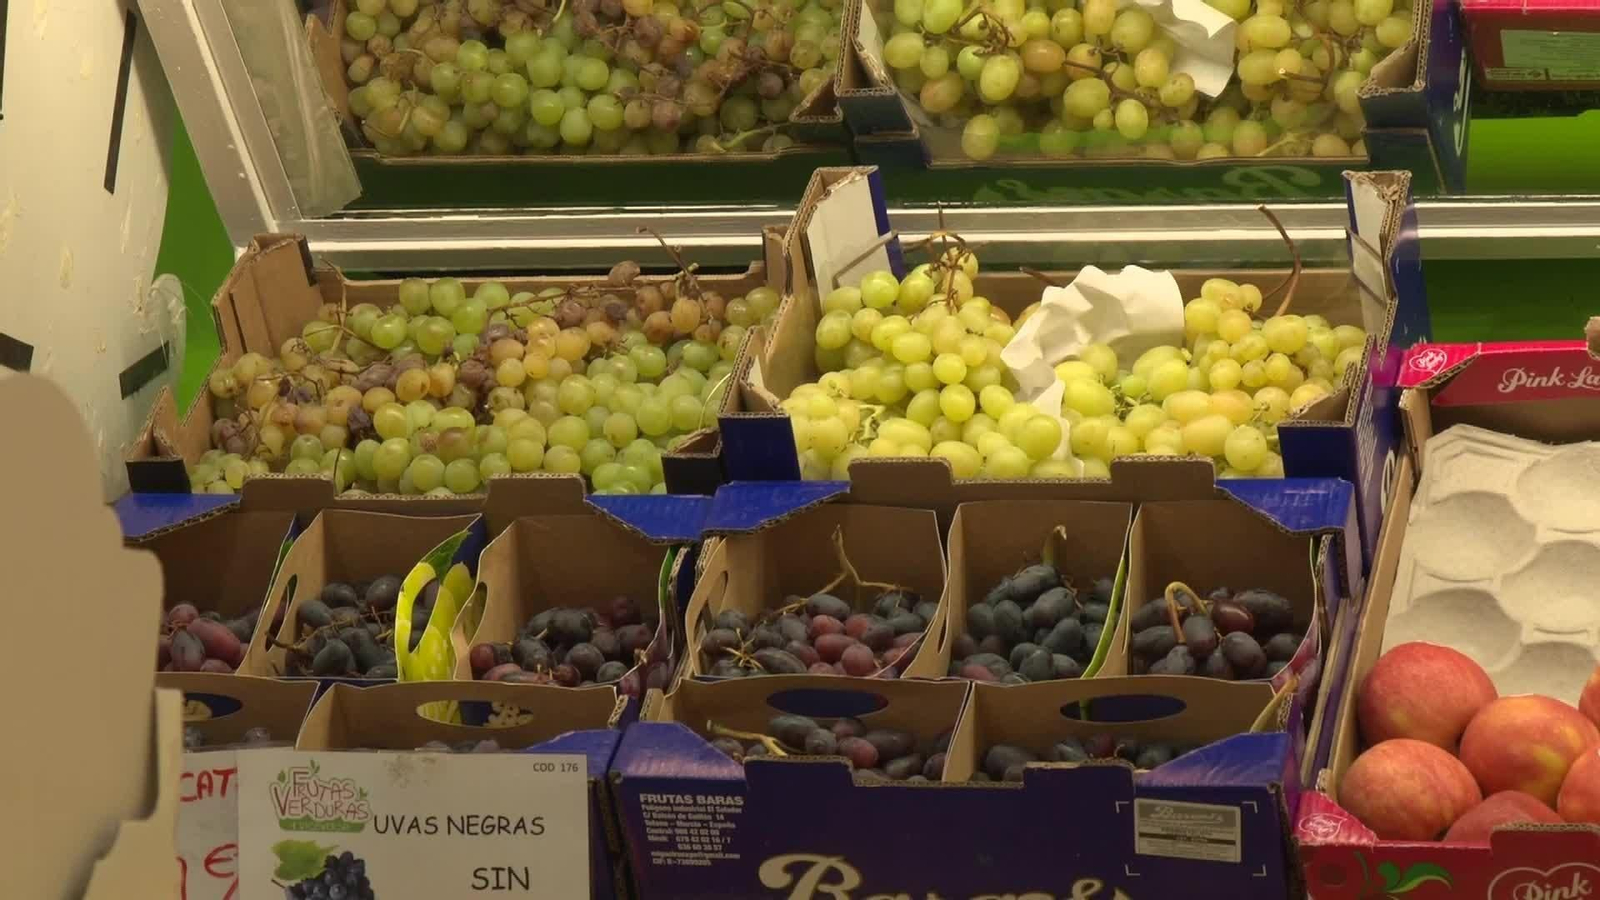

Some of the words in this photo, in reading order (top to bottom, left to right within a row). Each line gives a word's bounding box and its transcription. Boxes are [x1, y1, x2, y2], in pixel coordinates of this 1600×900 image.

[1498, 366, 1565, 393] Pink
[533, 763, 555, 773] COD
[561, 763, 579, 773] 176
[292, 771, 355, 800] FRUTAS
[273, 786, 370, 820] VERDURAS
[639, 793, 694, 804] FRUTAS
[696, 795, 744, 805] BARAS
[374, 815, 439, 836] UVAS
[447, 814, 546, 836] NEGRAS
[471, 866, 530, 891] SIN
[1513, 872, 1593, 900] Pink
